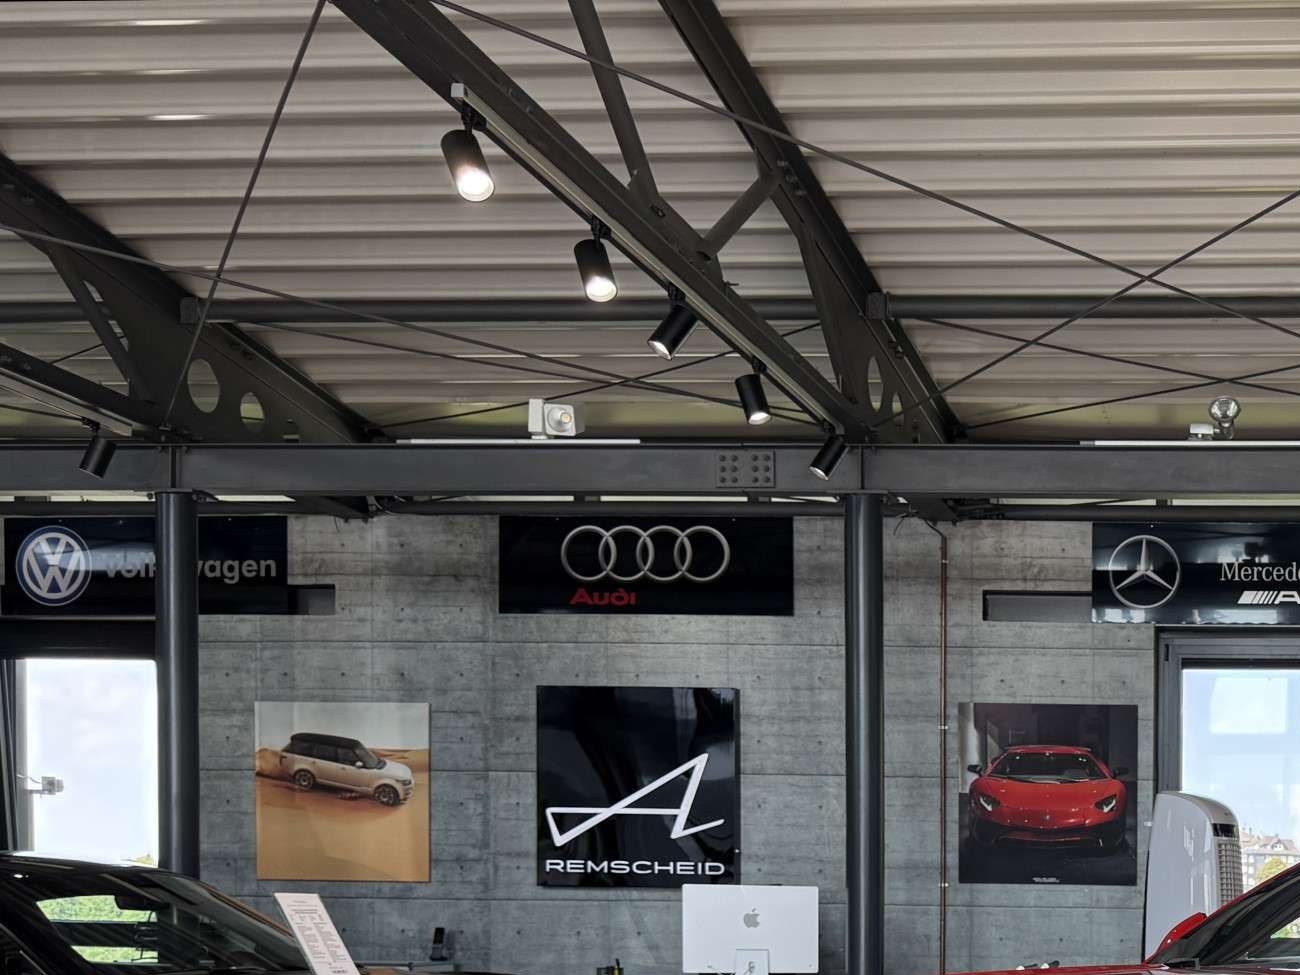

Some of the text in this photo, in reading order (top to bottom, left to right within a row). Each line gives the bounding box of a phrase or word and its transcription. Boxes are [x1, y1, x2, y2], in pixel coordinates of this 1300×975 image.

[105, 555, 277, 584] Volagen
[569, 587, 637, 606] Audi
[545, 859, 725, 876] REMSCHEID
